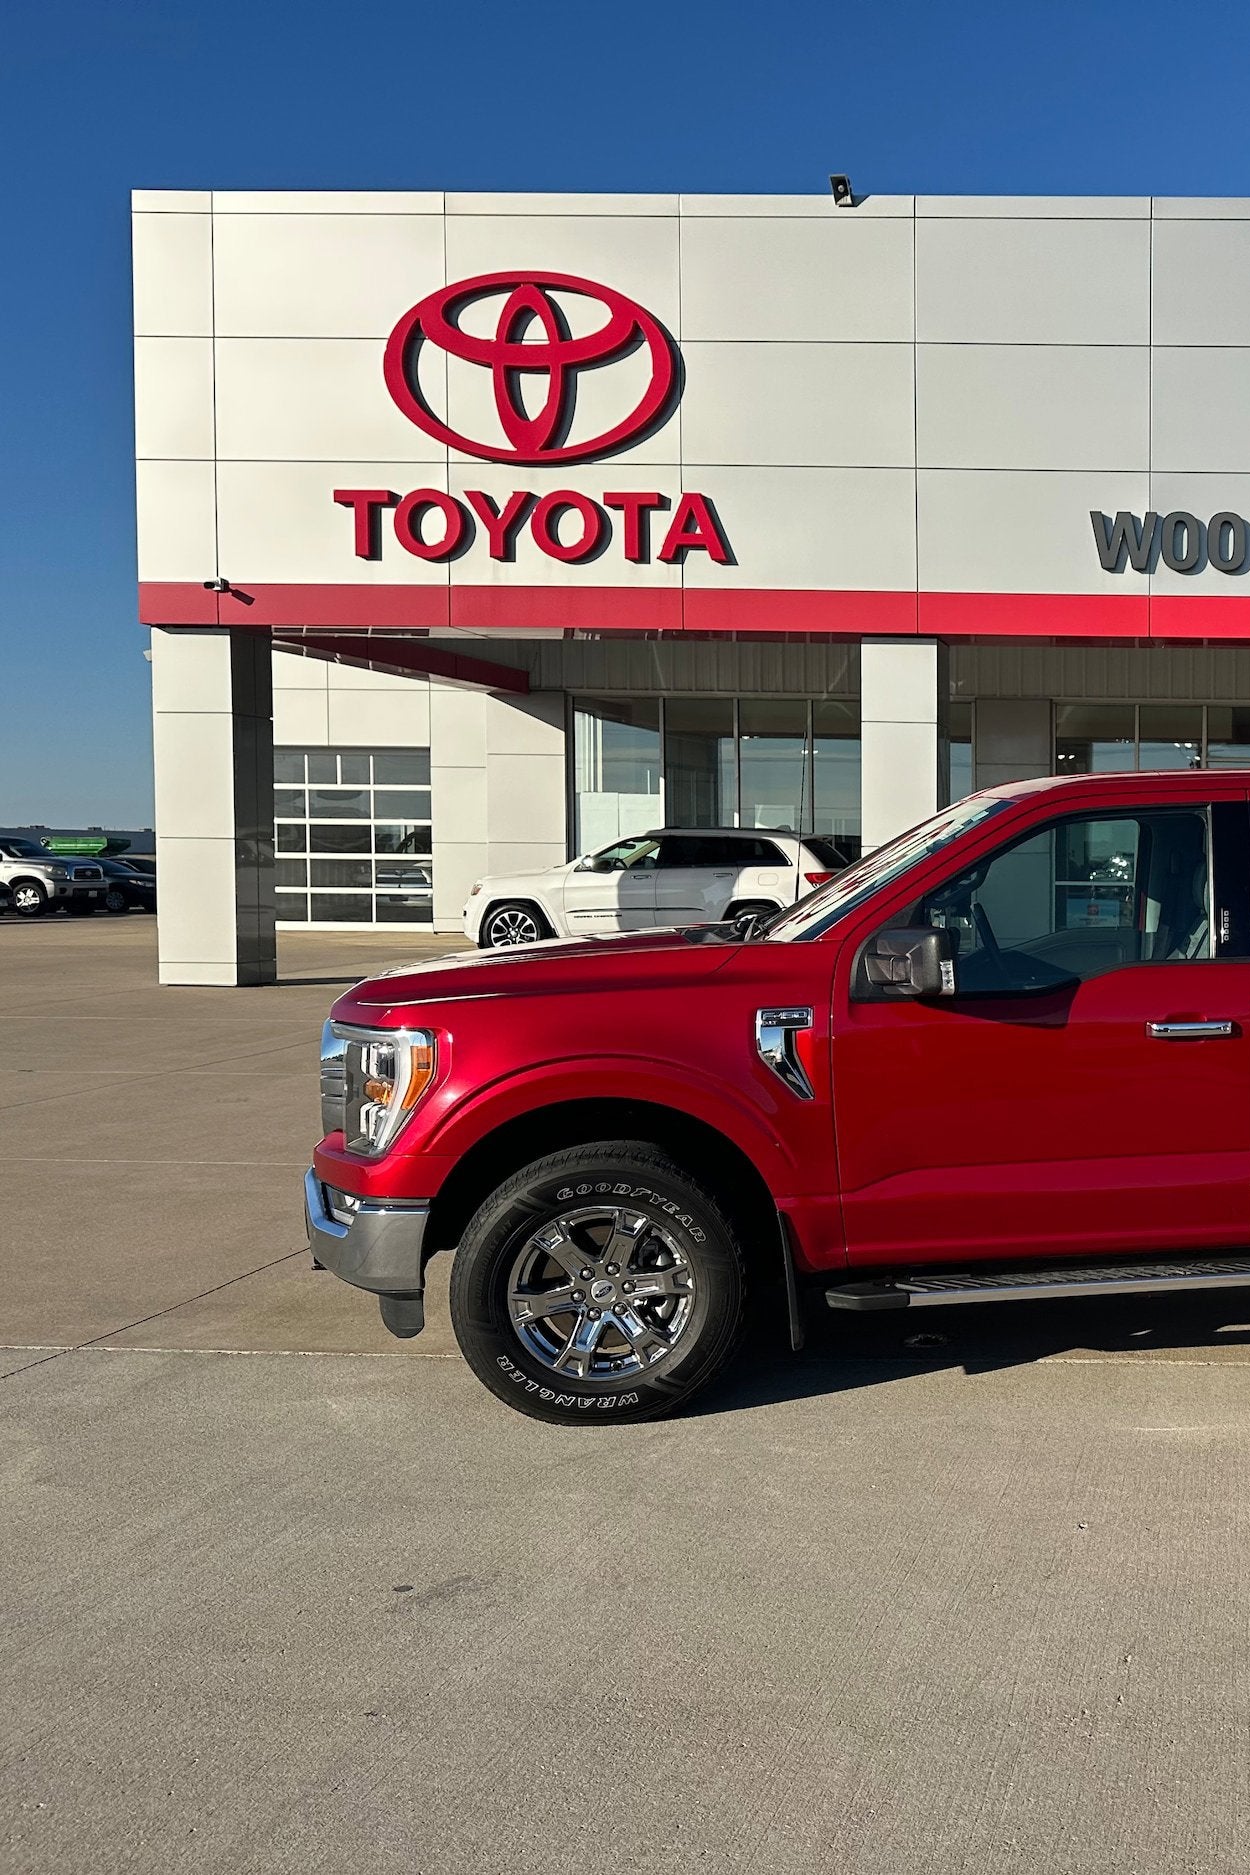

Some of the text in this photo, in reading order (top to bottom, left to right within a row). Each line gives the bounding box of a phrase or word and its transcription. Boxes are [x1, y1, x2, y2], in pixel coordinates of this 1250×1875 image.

[333, 488, 738, 566] TOYOTA
[556, 1182, 707, 1244] GOODYEAR
[495, 1352, 640, 1410] WRANGLER
